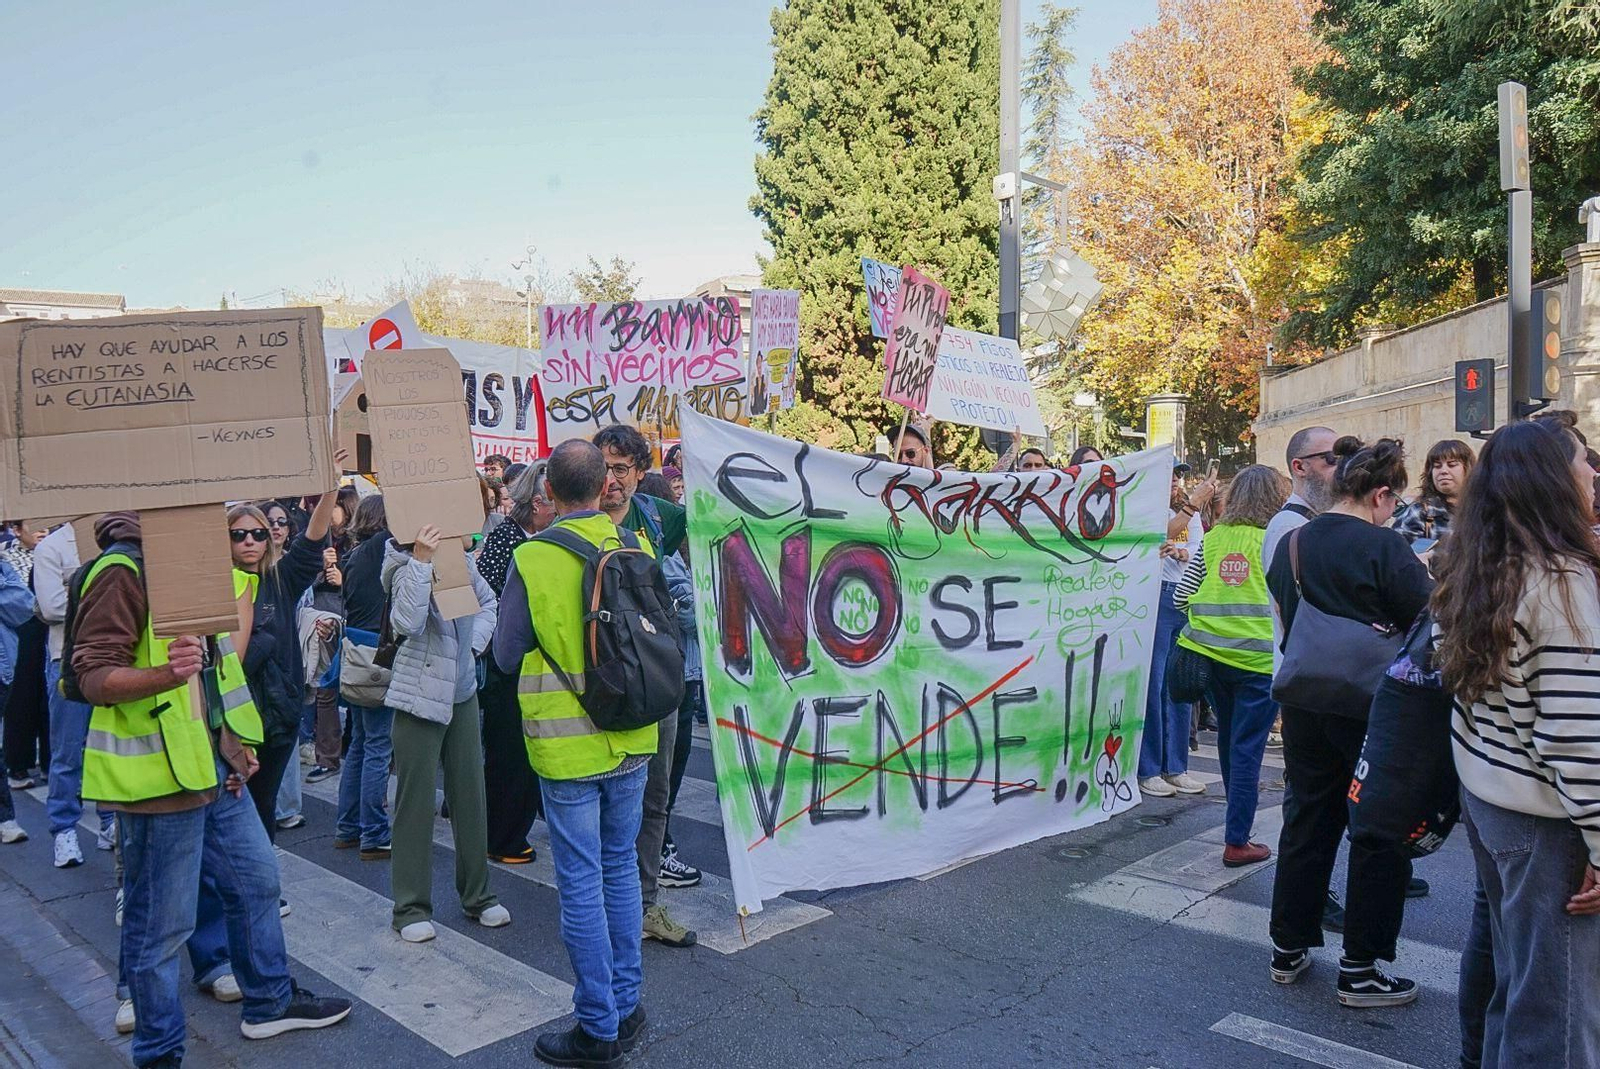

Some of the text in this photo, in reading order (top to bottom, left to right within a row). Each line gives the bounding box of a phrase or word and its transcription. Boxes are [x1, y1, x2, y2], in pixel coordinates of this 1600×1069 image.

[52, 331, 288, 360] HAY QUE AYUDAR A LOS
[943, 332, 973, 352] 754
[32, 354, 278, 385] RENTISTAS A HACERSE
[374, 368, 440, 385] NOSOTROS
[36, 381, 195, 407] LA EUTANASIA
[399, 387, 419, 400] LOS
[389, 424, 451, 440] RENTISTAS
[408, 443, 427, 455] LOS
[391, 458, 450, 478] PIOJOS
[1221, 560, 1249, 572] STOP
[843, 587, 864, 605] NO
[907, 578, 929, 596] NO
[709, 517, 1024, 692] NO SE
[841, 608, 868, 632] NO
